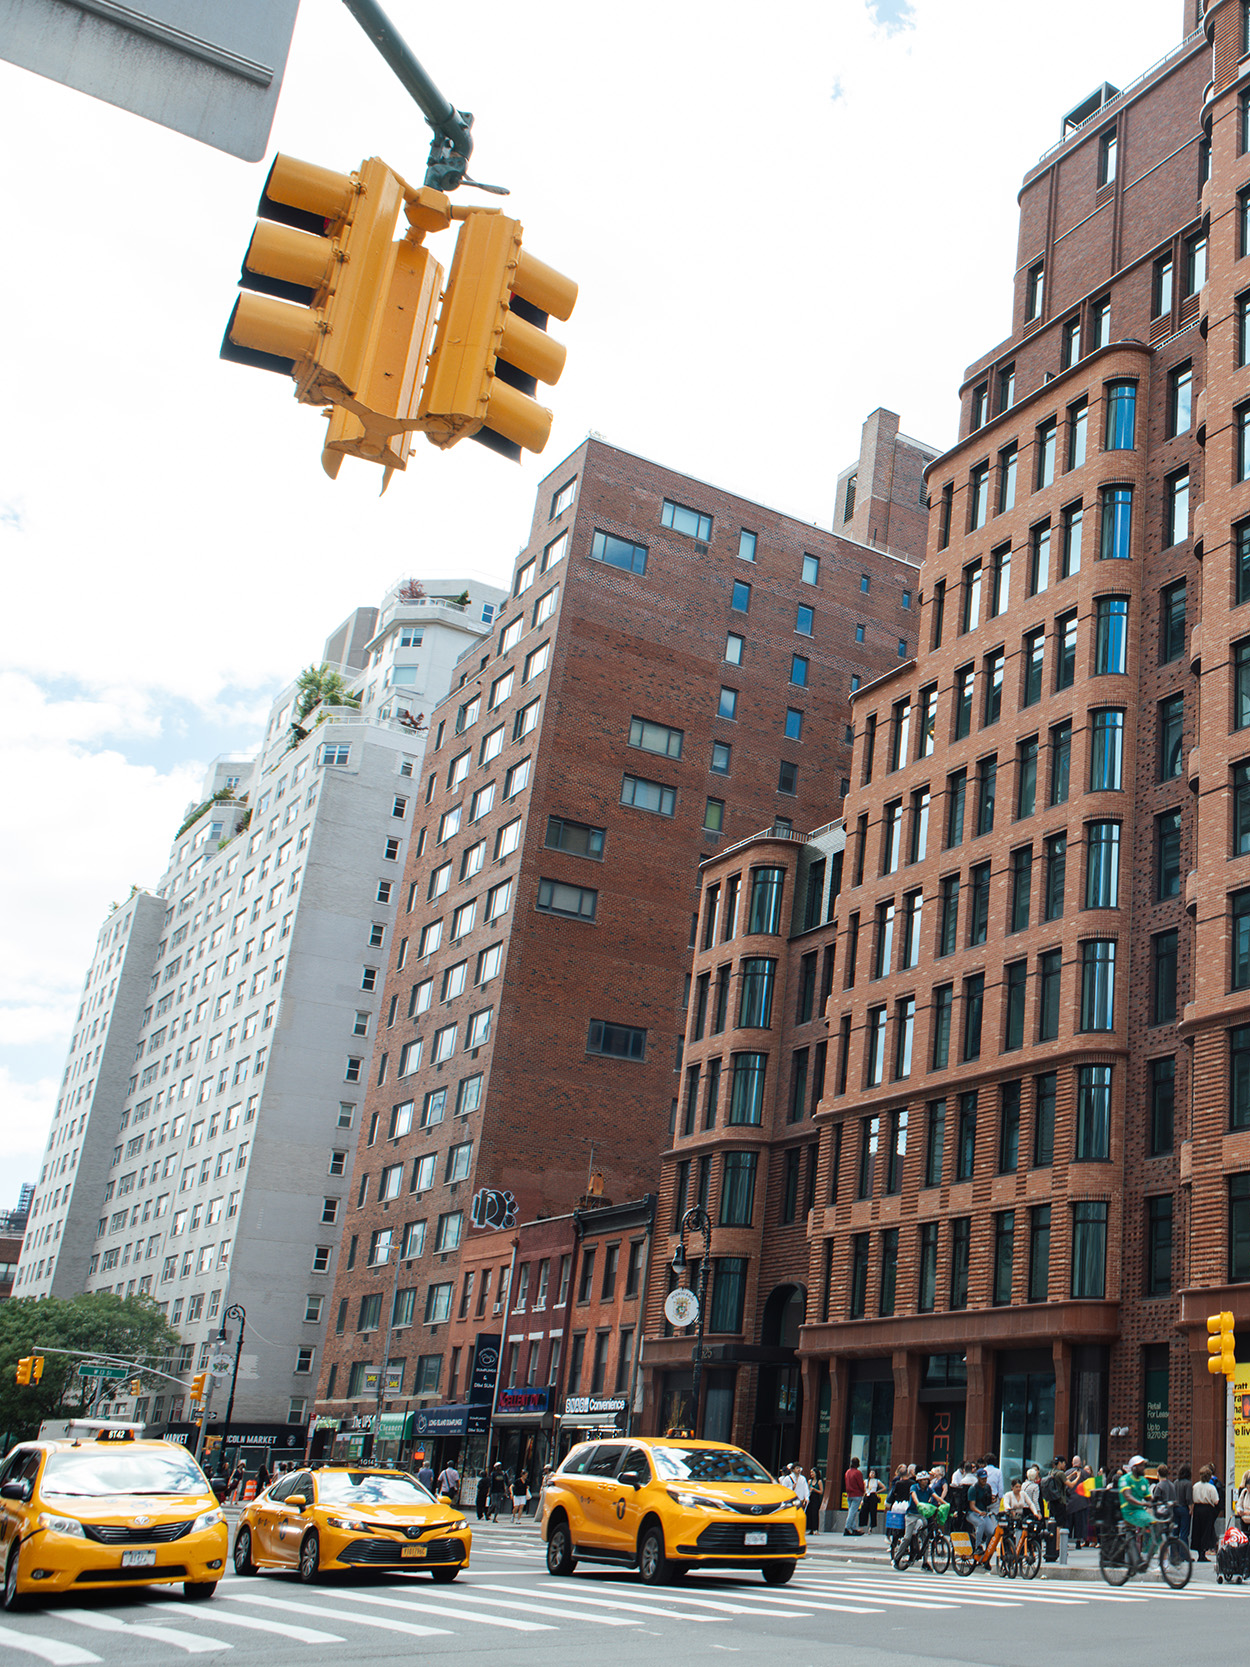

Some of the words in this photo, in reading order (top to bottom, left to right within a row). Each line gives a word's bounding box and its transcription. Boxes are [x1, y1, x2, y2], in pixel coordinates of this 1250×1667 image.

[1234, 1382, 1248, 1390] ratt
[589, 1397, 626, 1411] Convenience
[1147, 1402, 1161, 1410] Retail
[1147, 1410, 1156, 1418] For
[107, 1430, 126, 1439] 8T42
[162, 1433, 189, 1445] MARKET
[246, 1435, 277, 1444] MARKET
